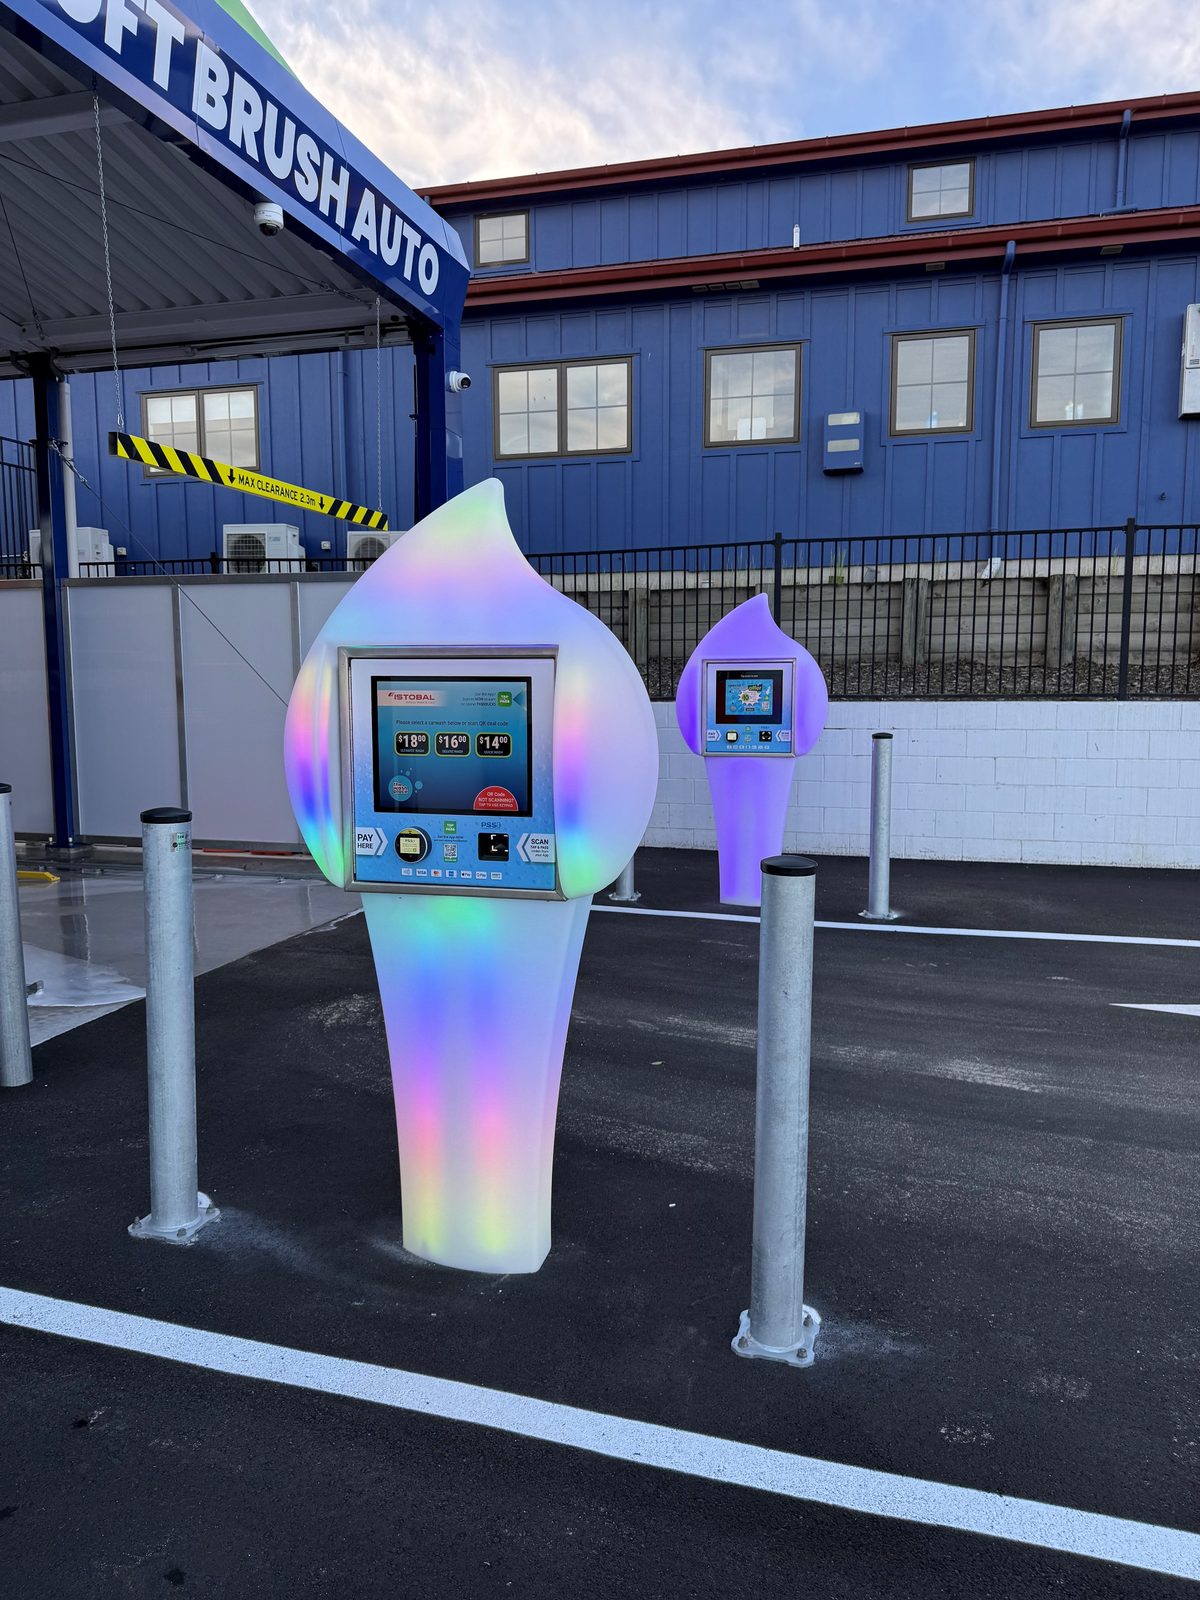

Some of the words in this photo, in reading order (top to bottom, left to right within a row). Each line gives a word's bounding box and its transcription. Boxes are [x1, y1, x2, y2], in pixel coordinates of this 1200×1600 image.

[56, 0, 185, 91] FT
[192, 39, 349, 229] BRUSH
[351, 188, 439, 296] AUTO
[238, 473, 256, 488] MAX
[256, 478, 298, 501] CLEARANCE
[299, 492, 316, 507] 2.3m
[357, 833, 374, 842] PAY
